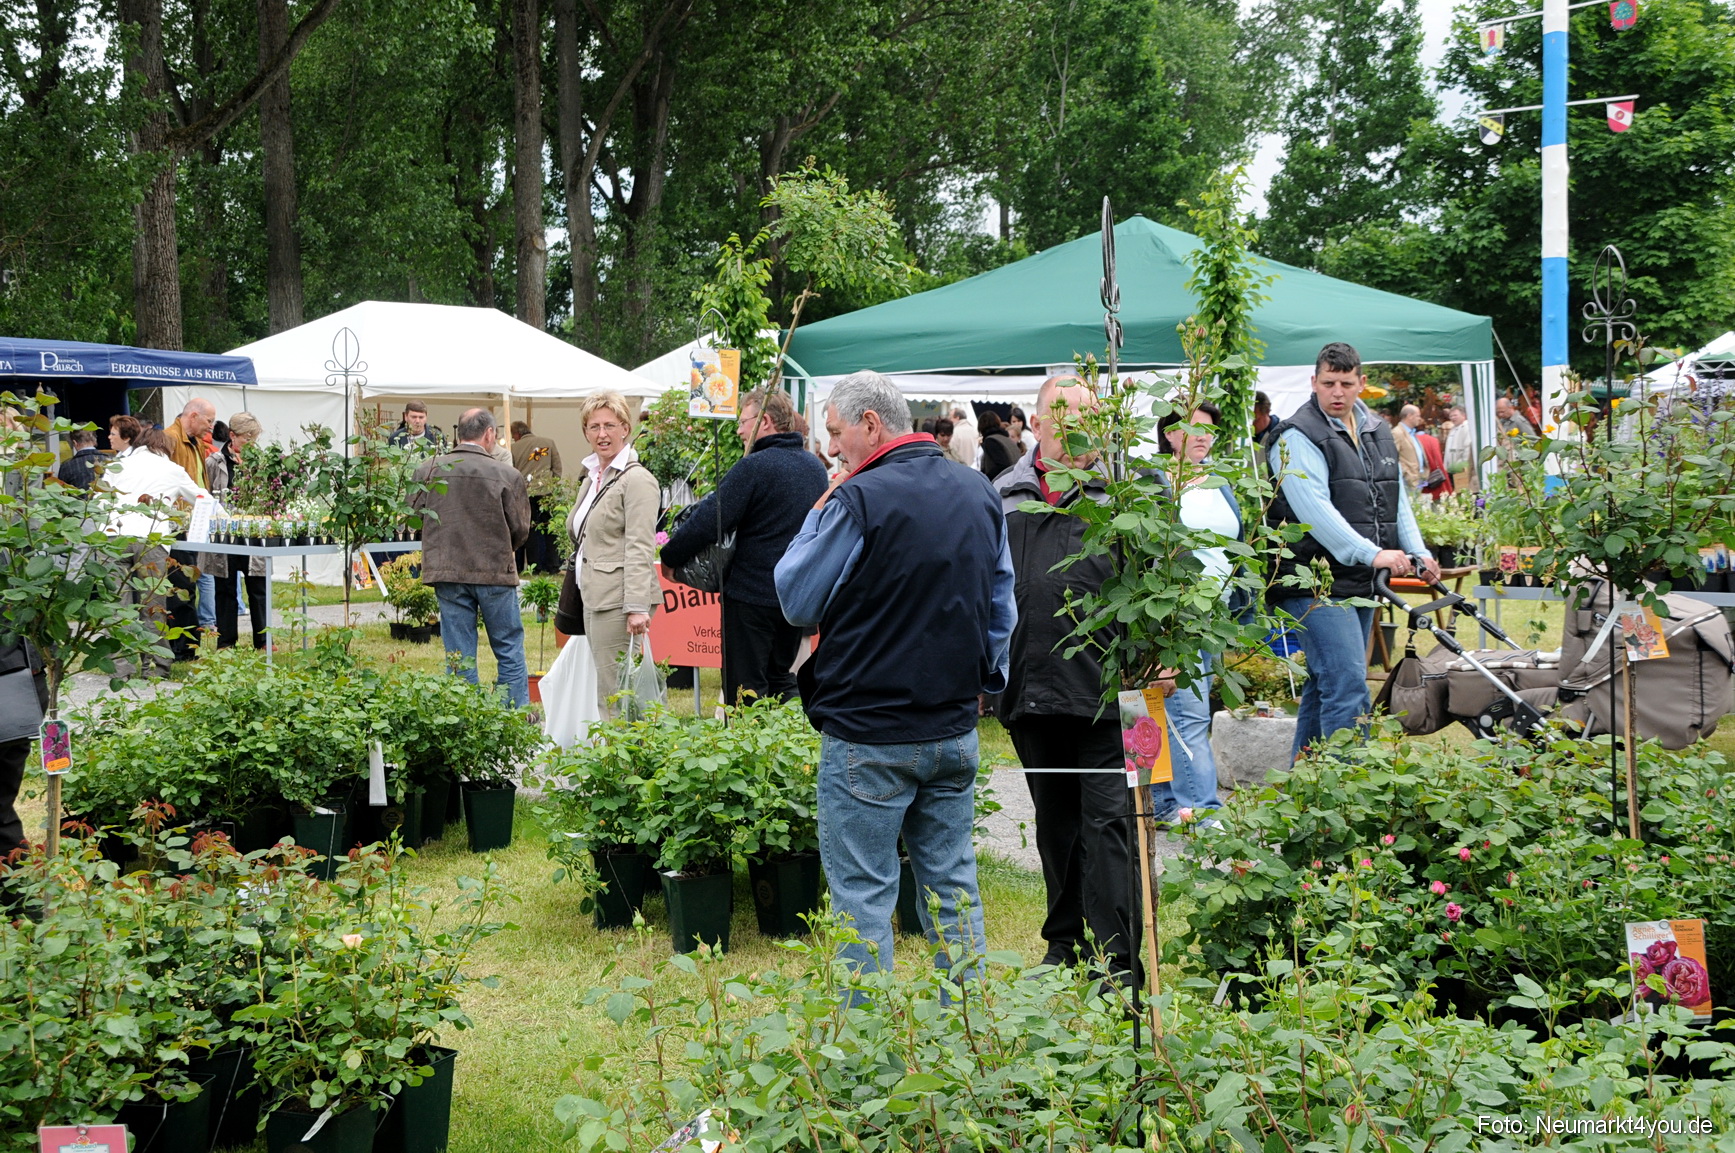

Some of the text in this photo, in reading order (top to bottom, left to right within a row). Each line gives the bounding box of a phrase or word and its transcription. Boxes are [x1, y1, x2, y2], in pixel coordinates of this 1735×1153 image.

[39, 351, 84, 372] Pausch
[111, 362, 237, 381] ERZEUGNISSE AUS KRETA
[687, 640, 722, 655] Sträuc
